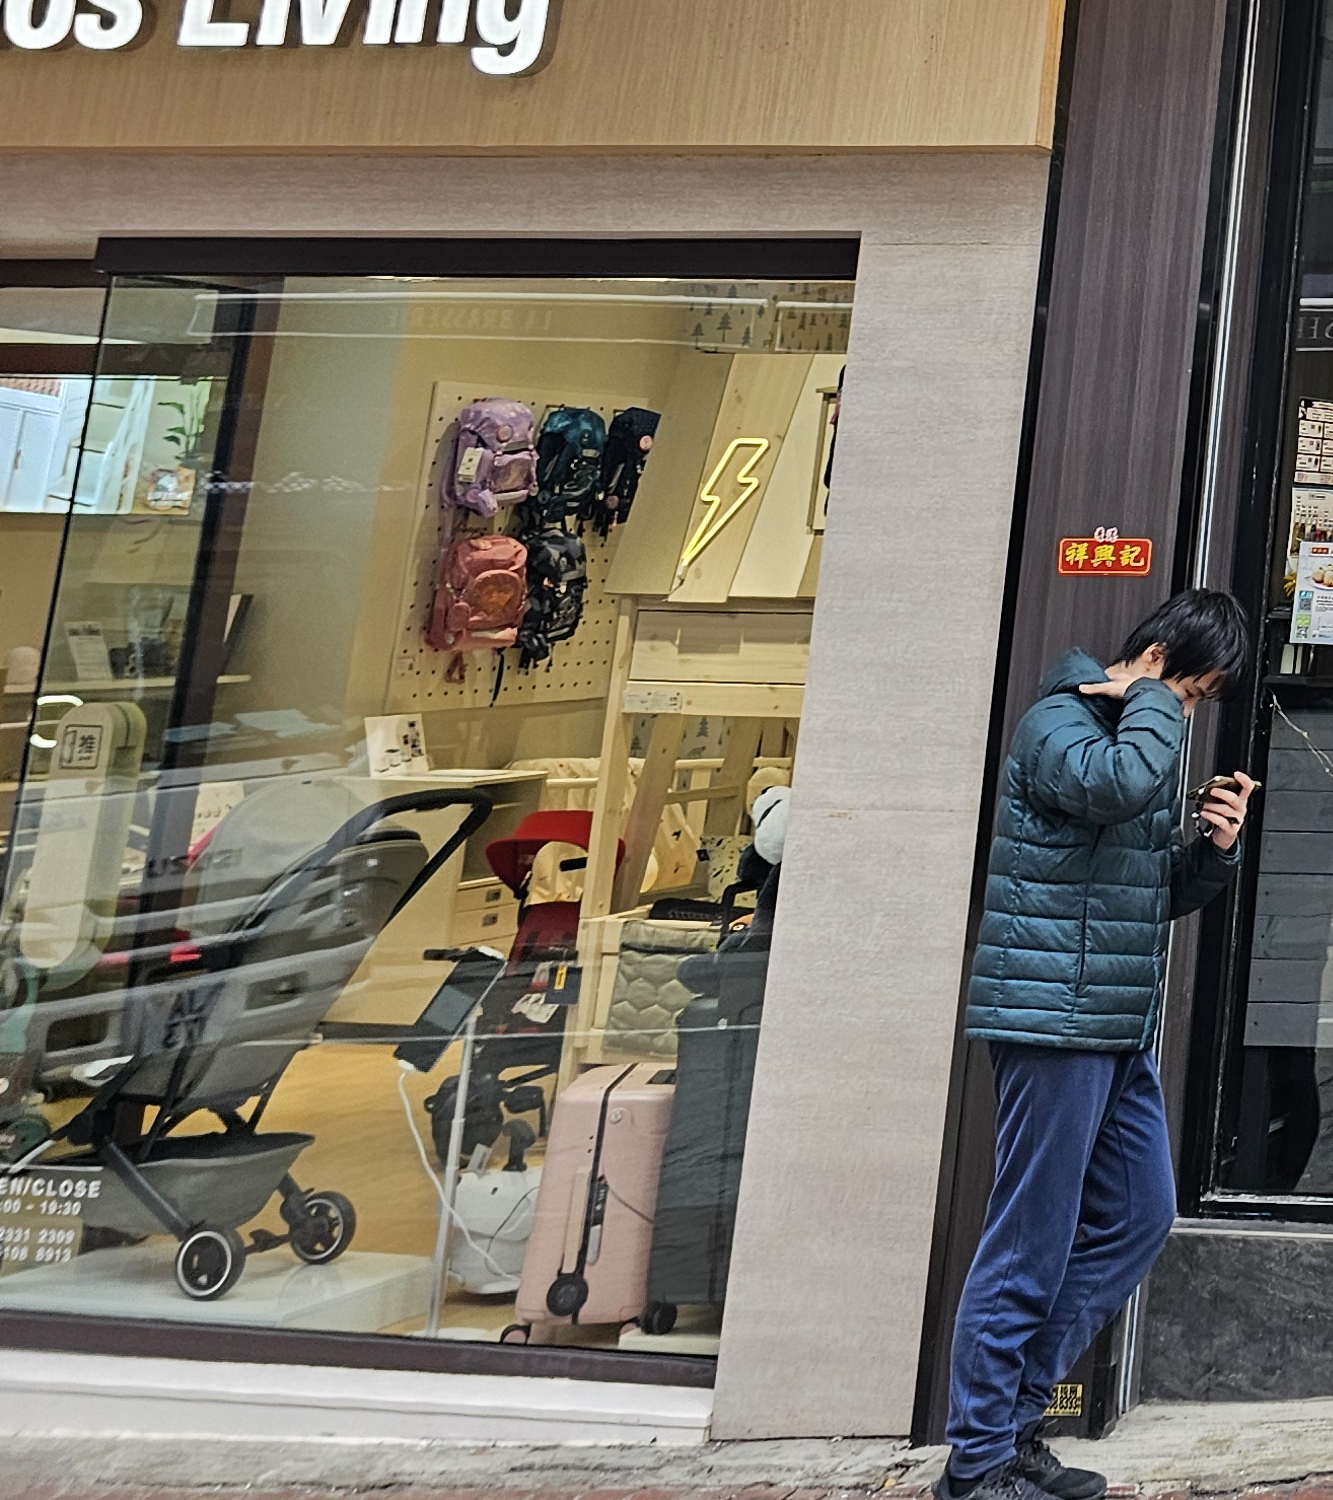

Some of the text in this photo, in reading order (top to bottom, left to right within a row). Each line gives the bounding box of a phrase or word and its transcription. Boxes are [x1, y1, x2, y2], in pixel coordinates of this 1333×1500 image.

[1064, 542, 1146, 569] 祥興記
[0, 1177, 102, 1198] EN/CLOSE
